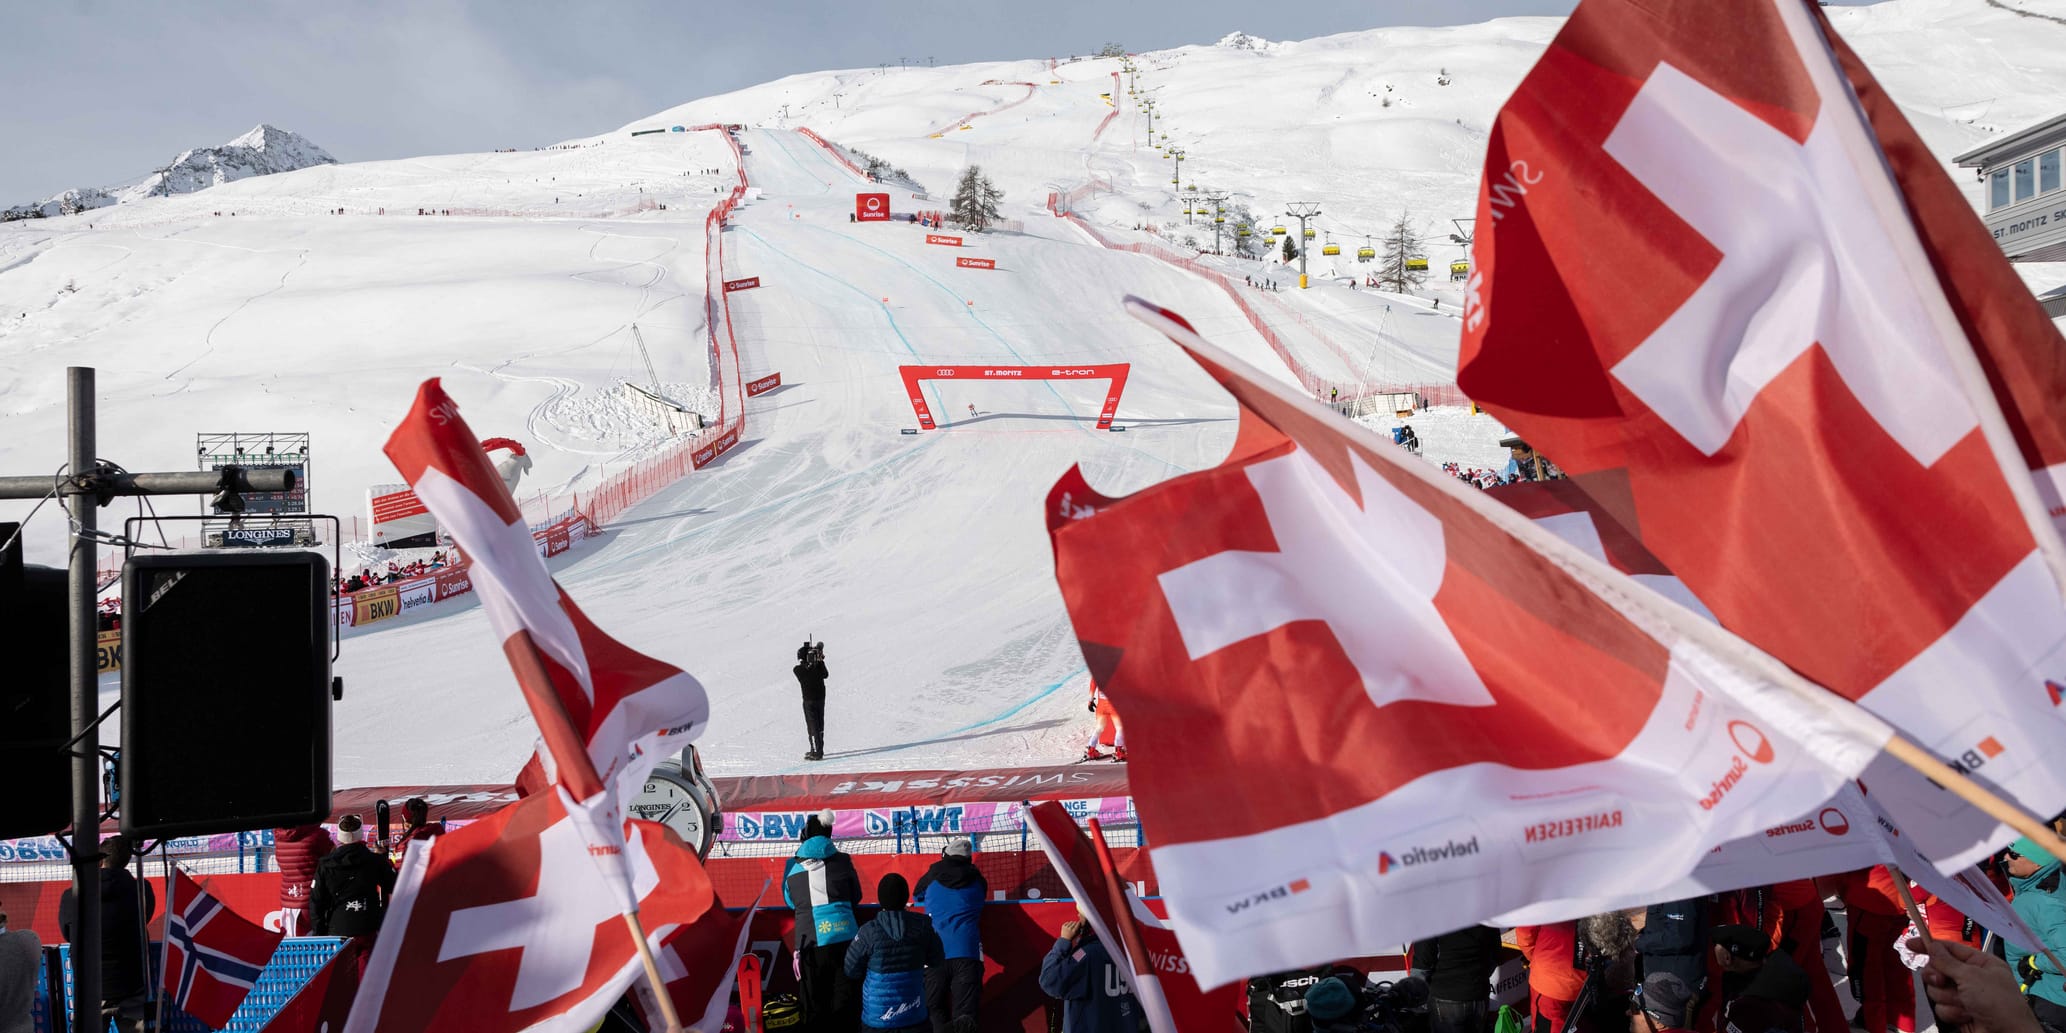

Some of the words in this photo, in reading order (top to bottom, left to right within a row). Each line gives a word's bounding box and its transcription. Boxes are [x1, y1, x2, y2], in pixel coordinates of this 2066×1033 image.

[937, 237, 959, 245] Sunrise
[968, 259, 990, 268] Sunrise
[735, 280, 756, 289] Sunrise
[757, 378, 777, 391] Sunrise
[228, 530, 291, 539] LONGINES
[150, 571, 187, 602] BELL
[448, 580, 469, 593] Sunrise
[402, 595, 427, 610] helvetia
[370, 599, 394, 620] BKW
[97, 645, 121, 669] BK
[668, 721, 694, 736] BKW
[644, 783, 656, 794] 12
[629, 803, 672, 812] LONGINES
[681, 802, 691, 812] 2
[1064, 801, 1087, 810] NGE
[763, 814, 805, 838] BW
[892, 806, 963, 833] BWT
[687, 822, 698, 833] 3
[17, 839, 65, 860] BW
[1488, 971, 1527, 995] AIFFEISEN
